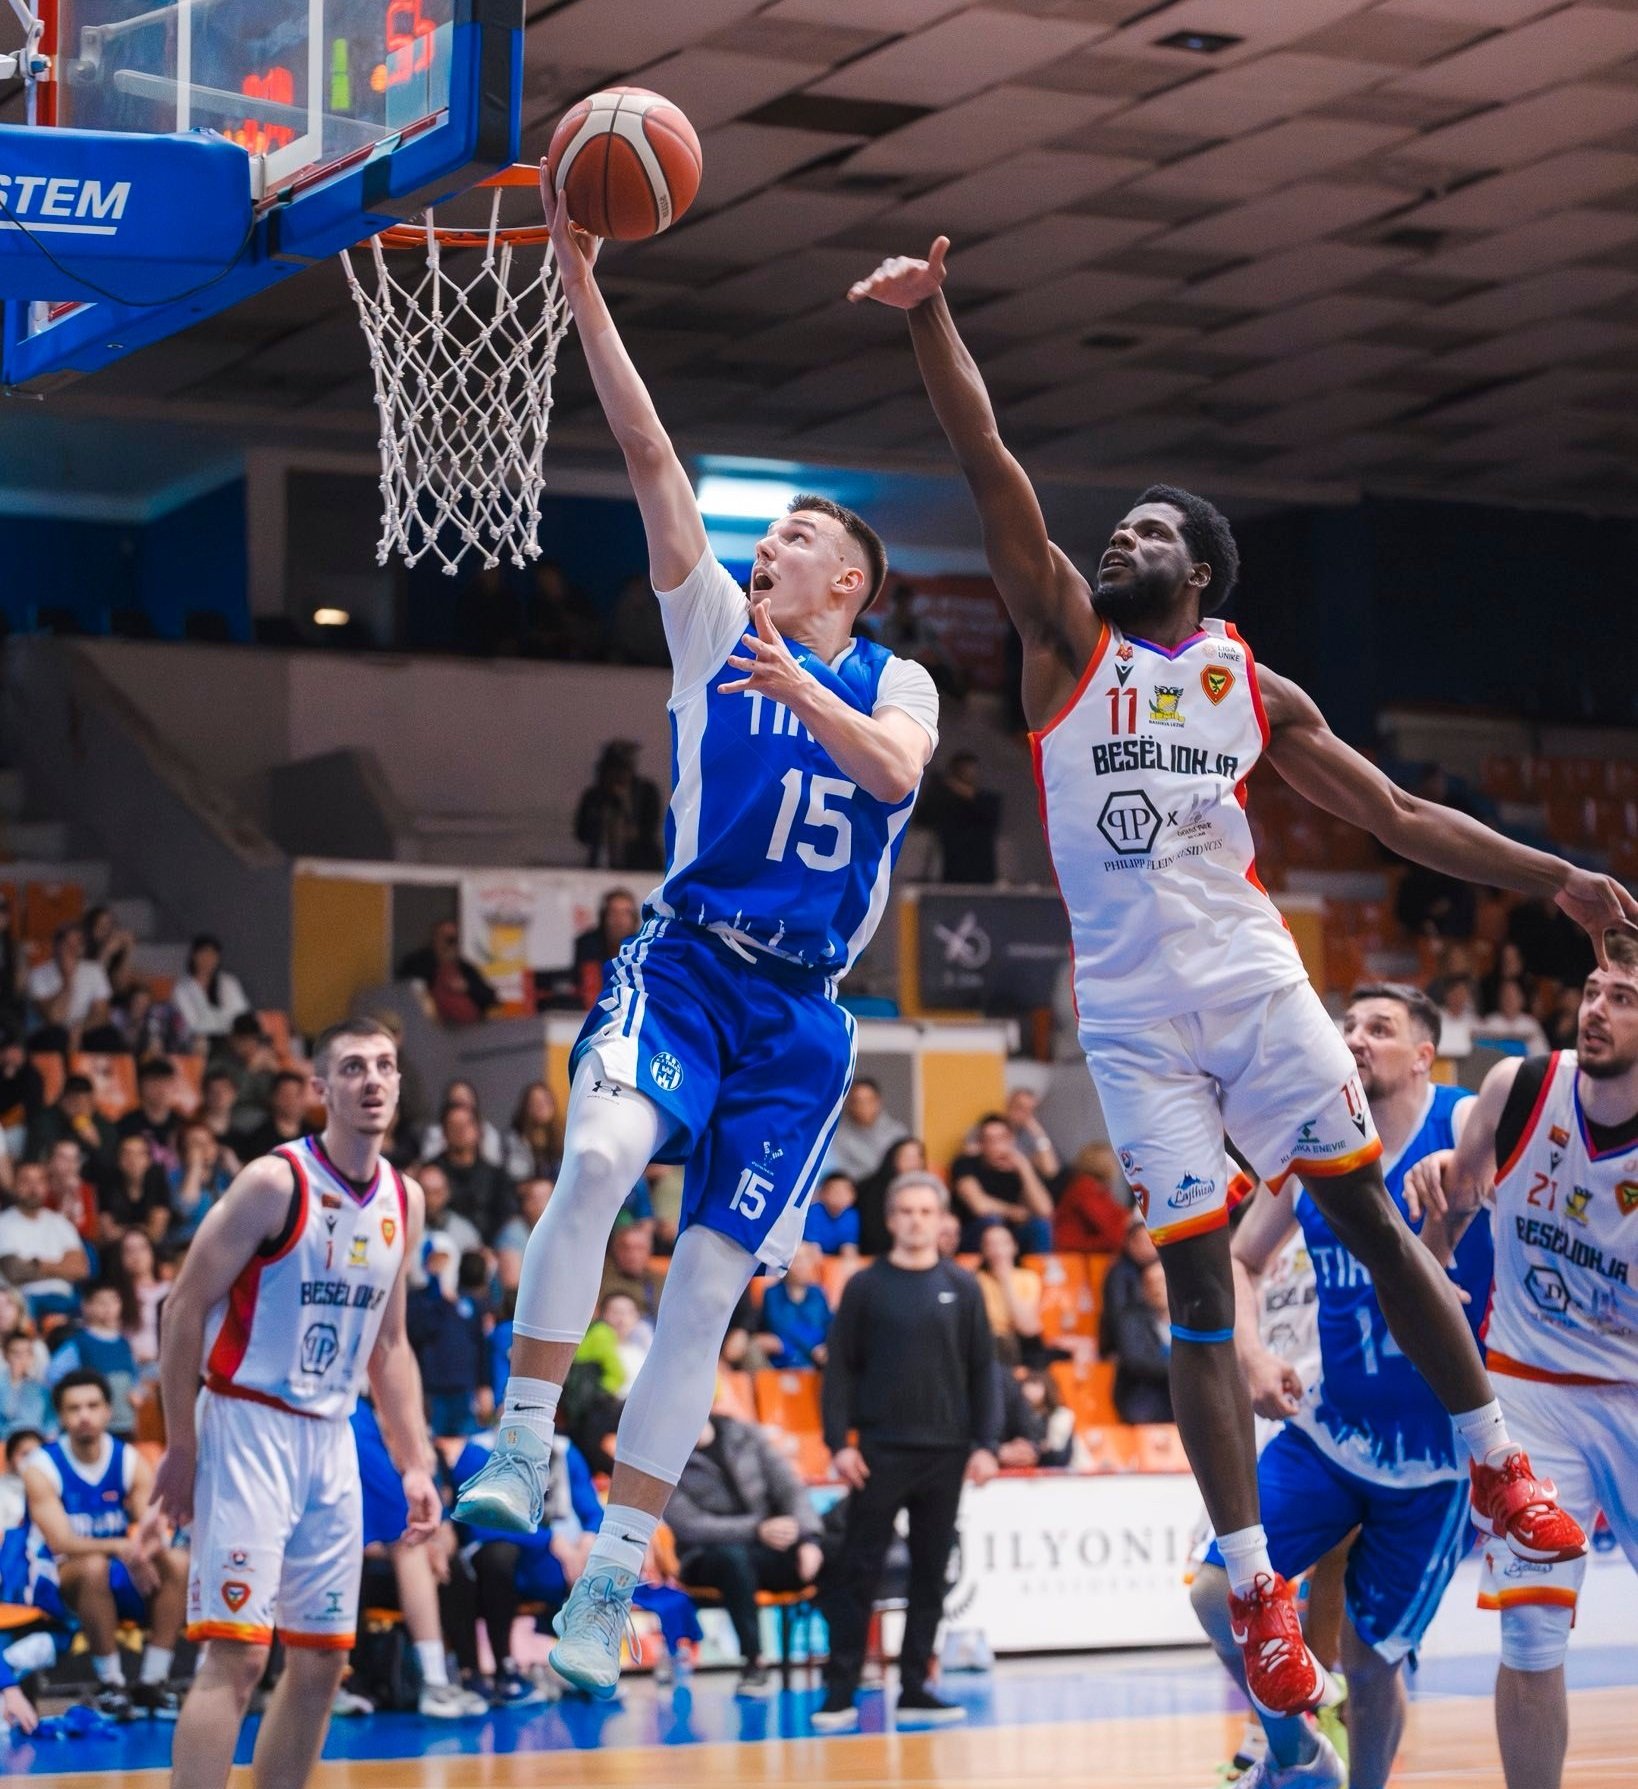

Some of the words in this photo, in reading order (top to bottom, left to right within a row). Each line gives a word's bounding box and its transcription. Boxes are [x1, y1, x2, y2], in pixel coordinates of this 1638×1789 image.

[1218, 651, 1240, 662] UNIKE
[1105, 687, 1138, 735] 11
[766, 767, 857, 873] 15
[1104, 858, 1145, 872] PHILIPP
[729, 1168, 775, 1221] 15
[1527, 1171, 1558, 1211] 21
[984, 1525, 1177, 1570] ILYONI
